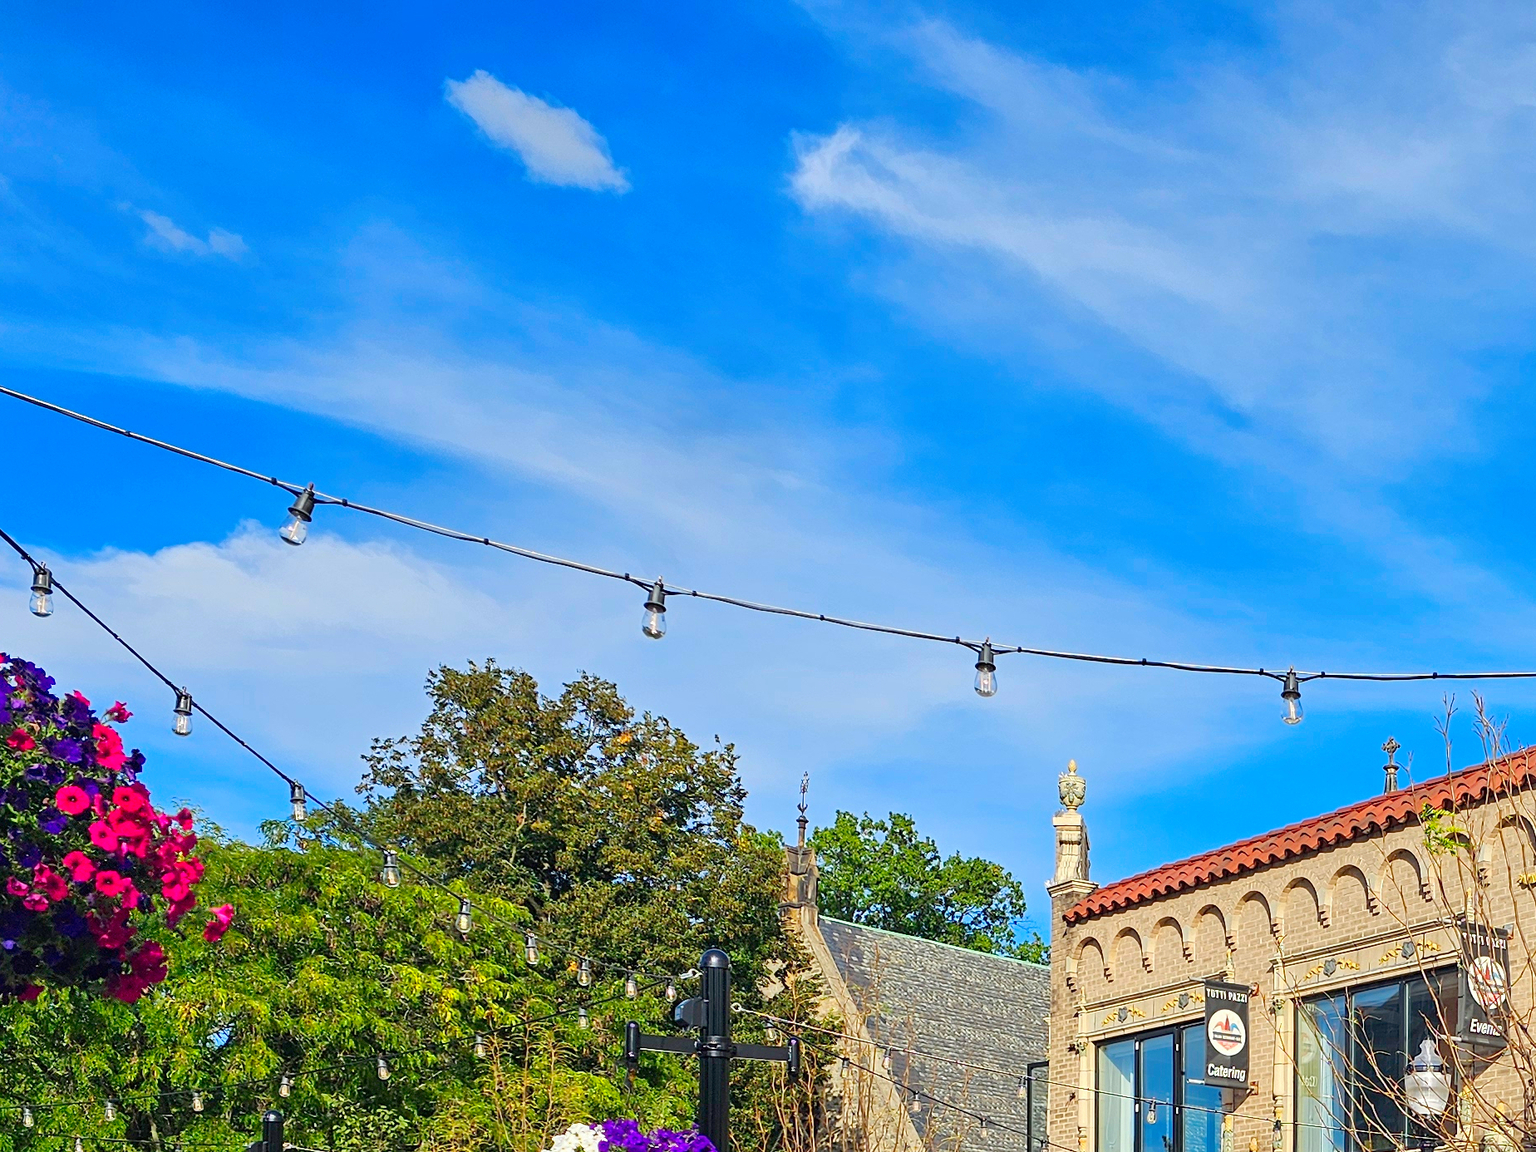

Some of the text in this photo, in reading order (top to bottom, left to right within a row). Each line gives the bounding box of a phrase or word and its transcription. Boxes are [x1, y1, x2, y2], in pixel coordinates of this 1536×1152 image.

[1206, 988, 1248, 1003] TUTTI PAZZI
[1207, 1063, 1246, 1082] Catering
